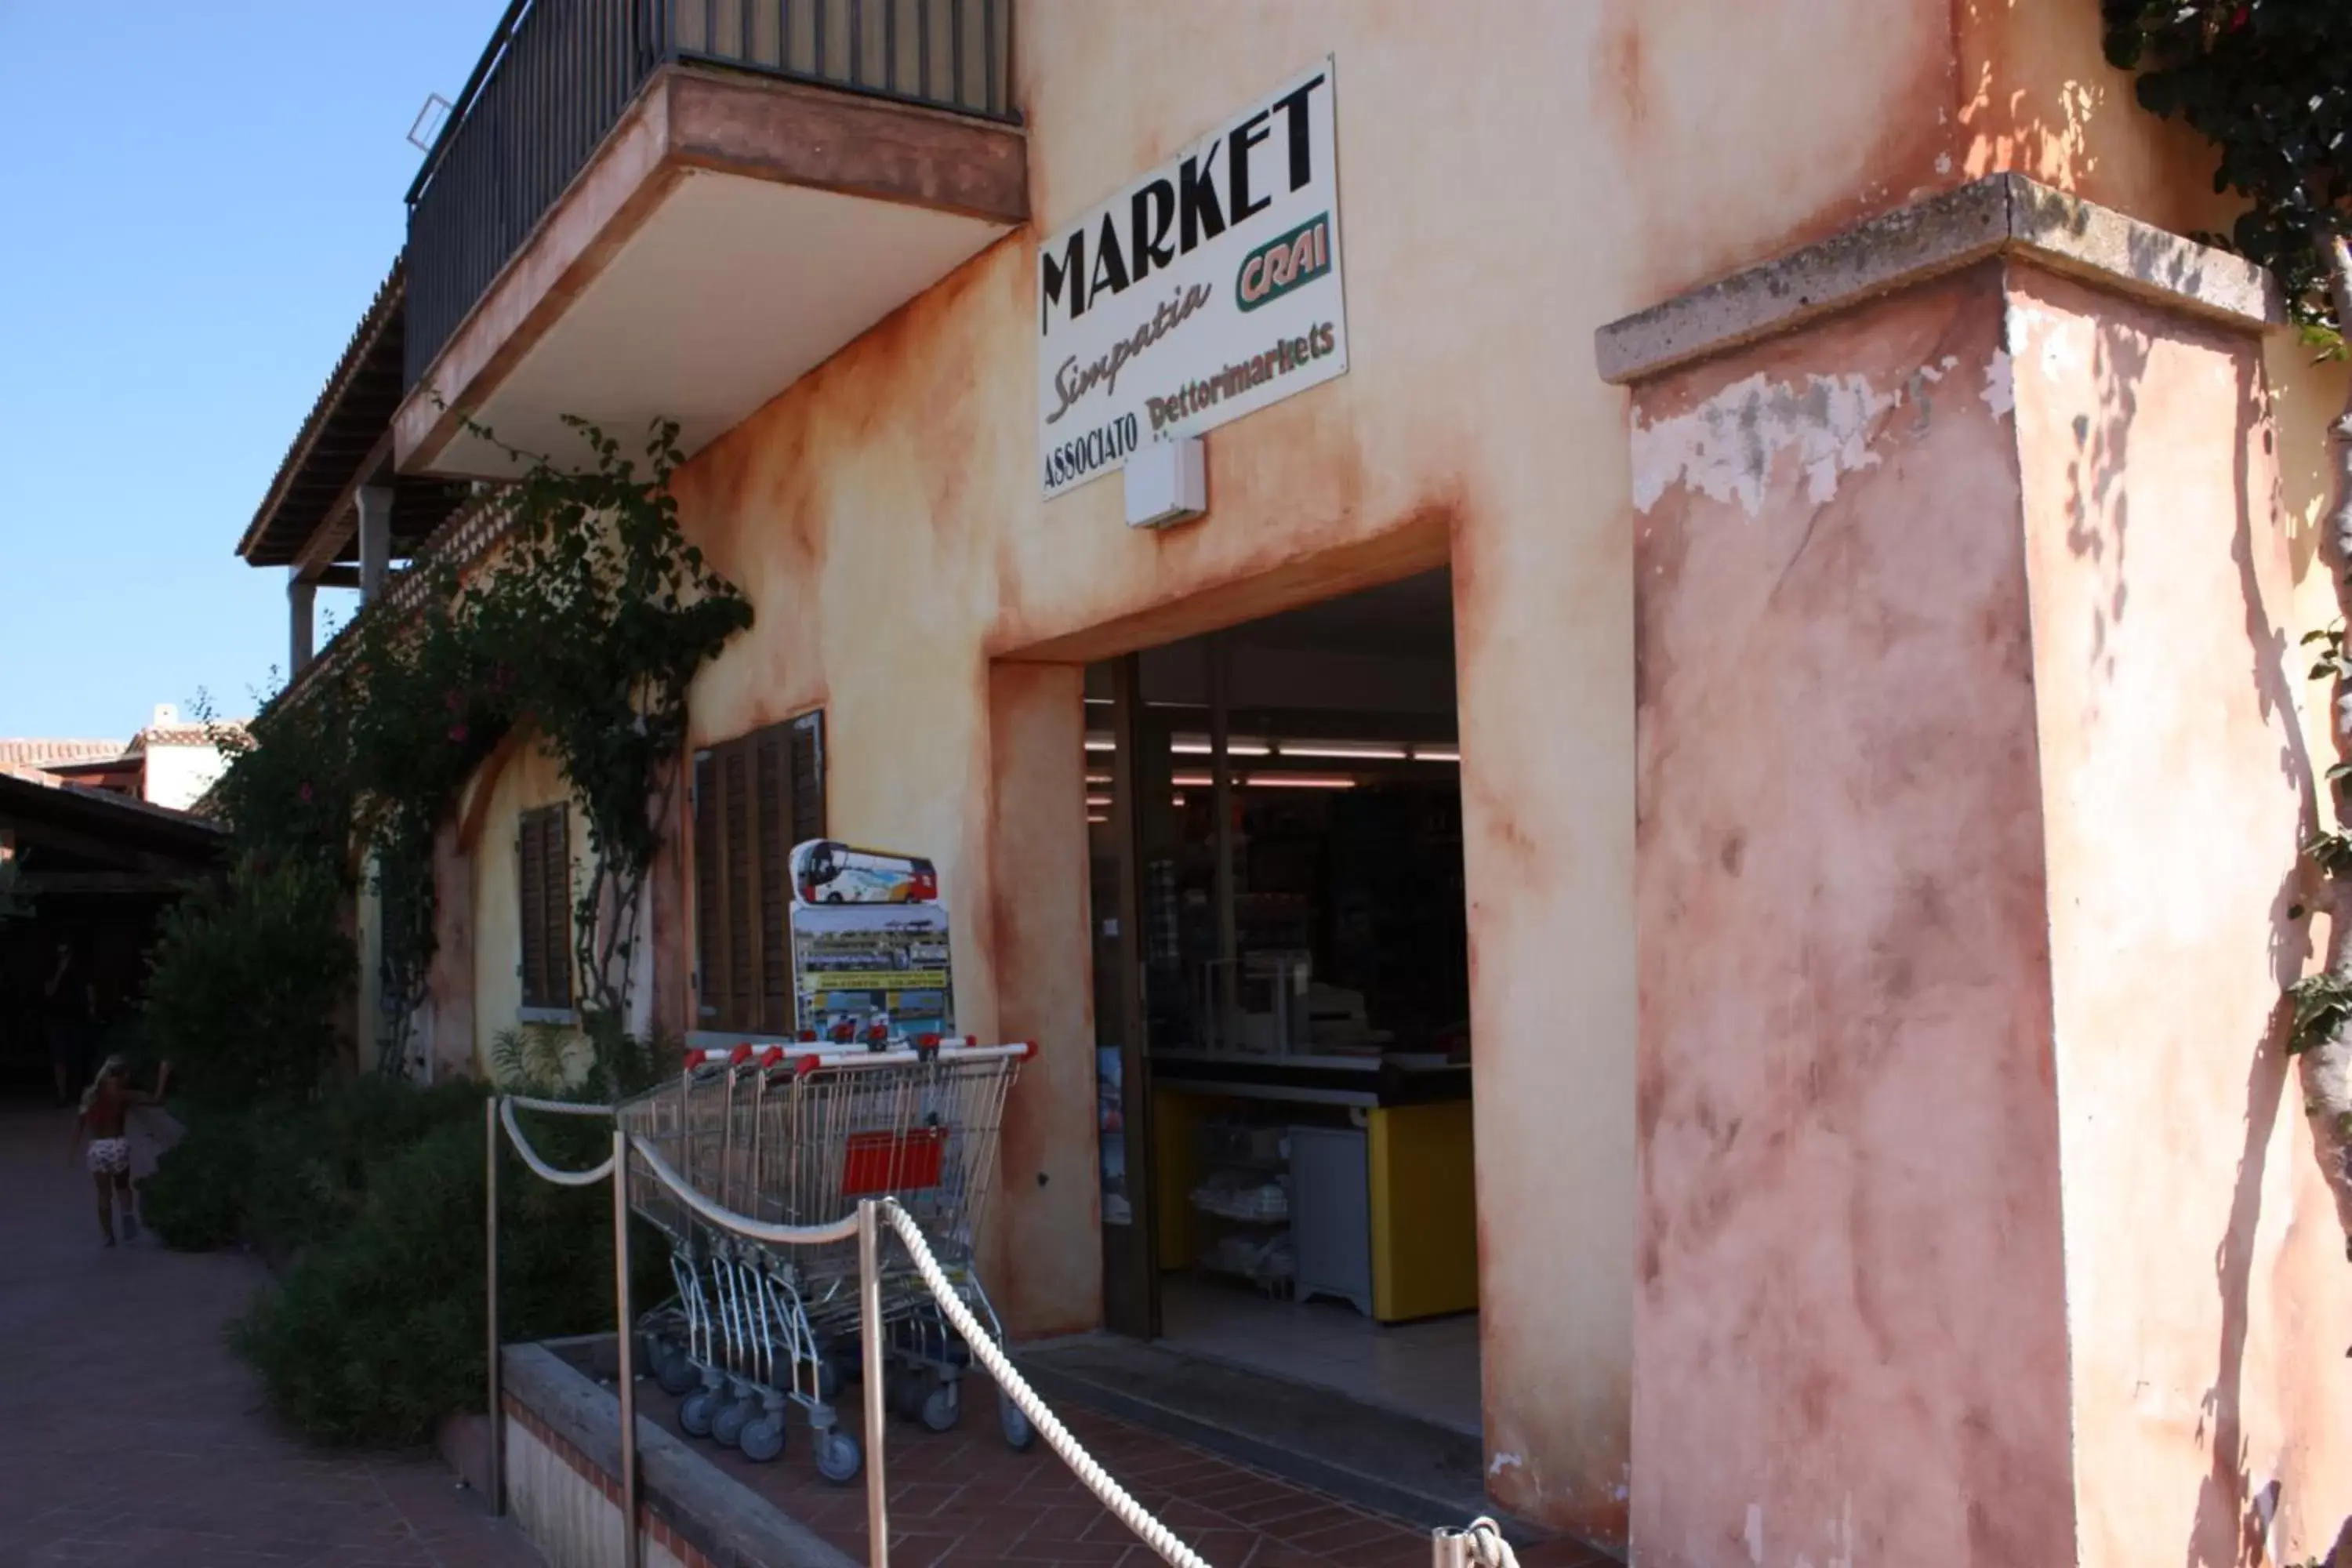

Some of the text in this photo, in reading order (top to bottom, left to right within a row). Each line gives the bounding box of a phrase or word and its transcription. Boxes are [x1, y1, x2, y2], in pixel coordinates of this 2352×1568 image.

[1043, 74, 1325, 336] MARKET
[1241, 223, 1326, 303] CRAI
[1044, 321, 1334, 491] ASSOCIATO Dettorimarkets
[1045, 283, 1212, 424] Simpatia
